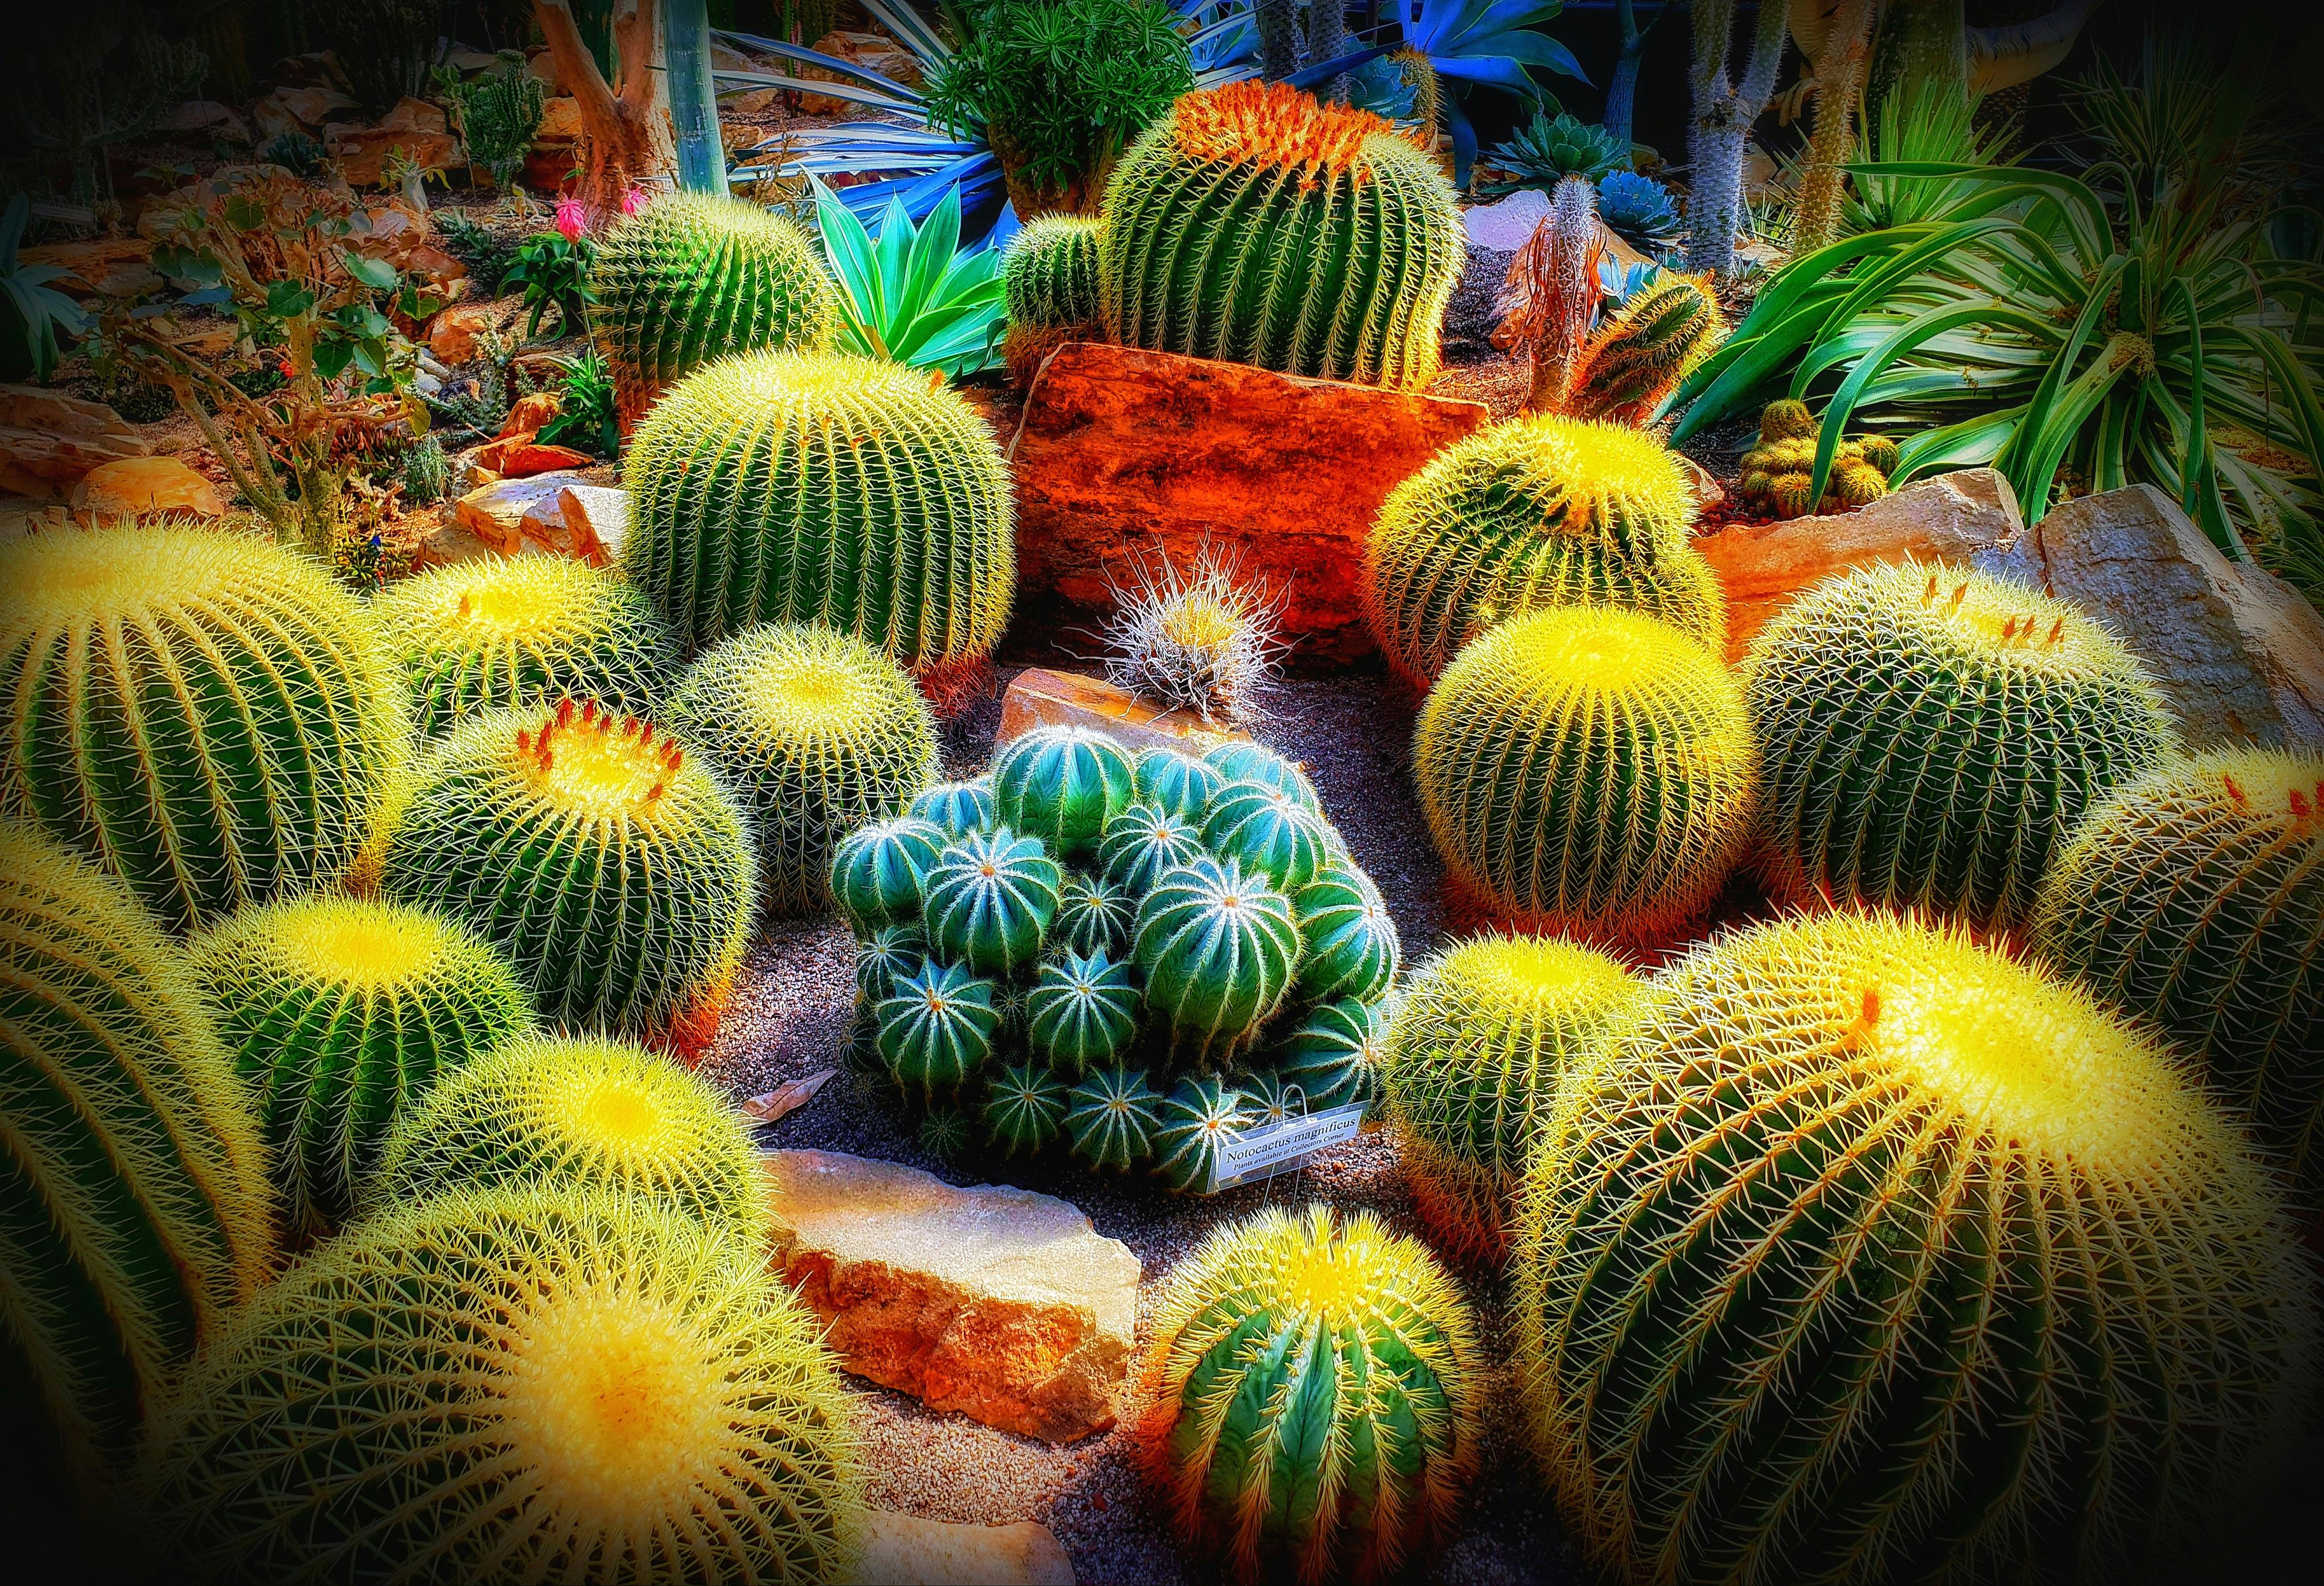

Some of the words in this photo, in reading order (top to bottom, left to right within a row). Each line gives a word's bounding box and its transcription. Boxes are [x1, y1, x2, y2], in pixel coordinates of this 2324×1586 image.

[1227, 1137, 1291, 1163] Notocactus
[1294, 1118, 1356, 1142] magnificus
[1233, 1159, 1253, 1170] Plants
[1254, 1151, 1282, 1163] available
[1291, 1139, 1322, 1152] Collectors
[1323, 1132, 1345, 1142] Corner
